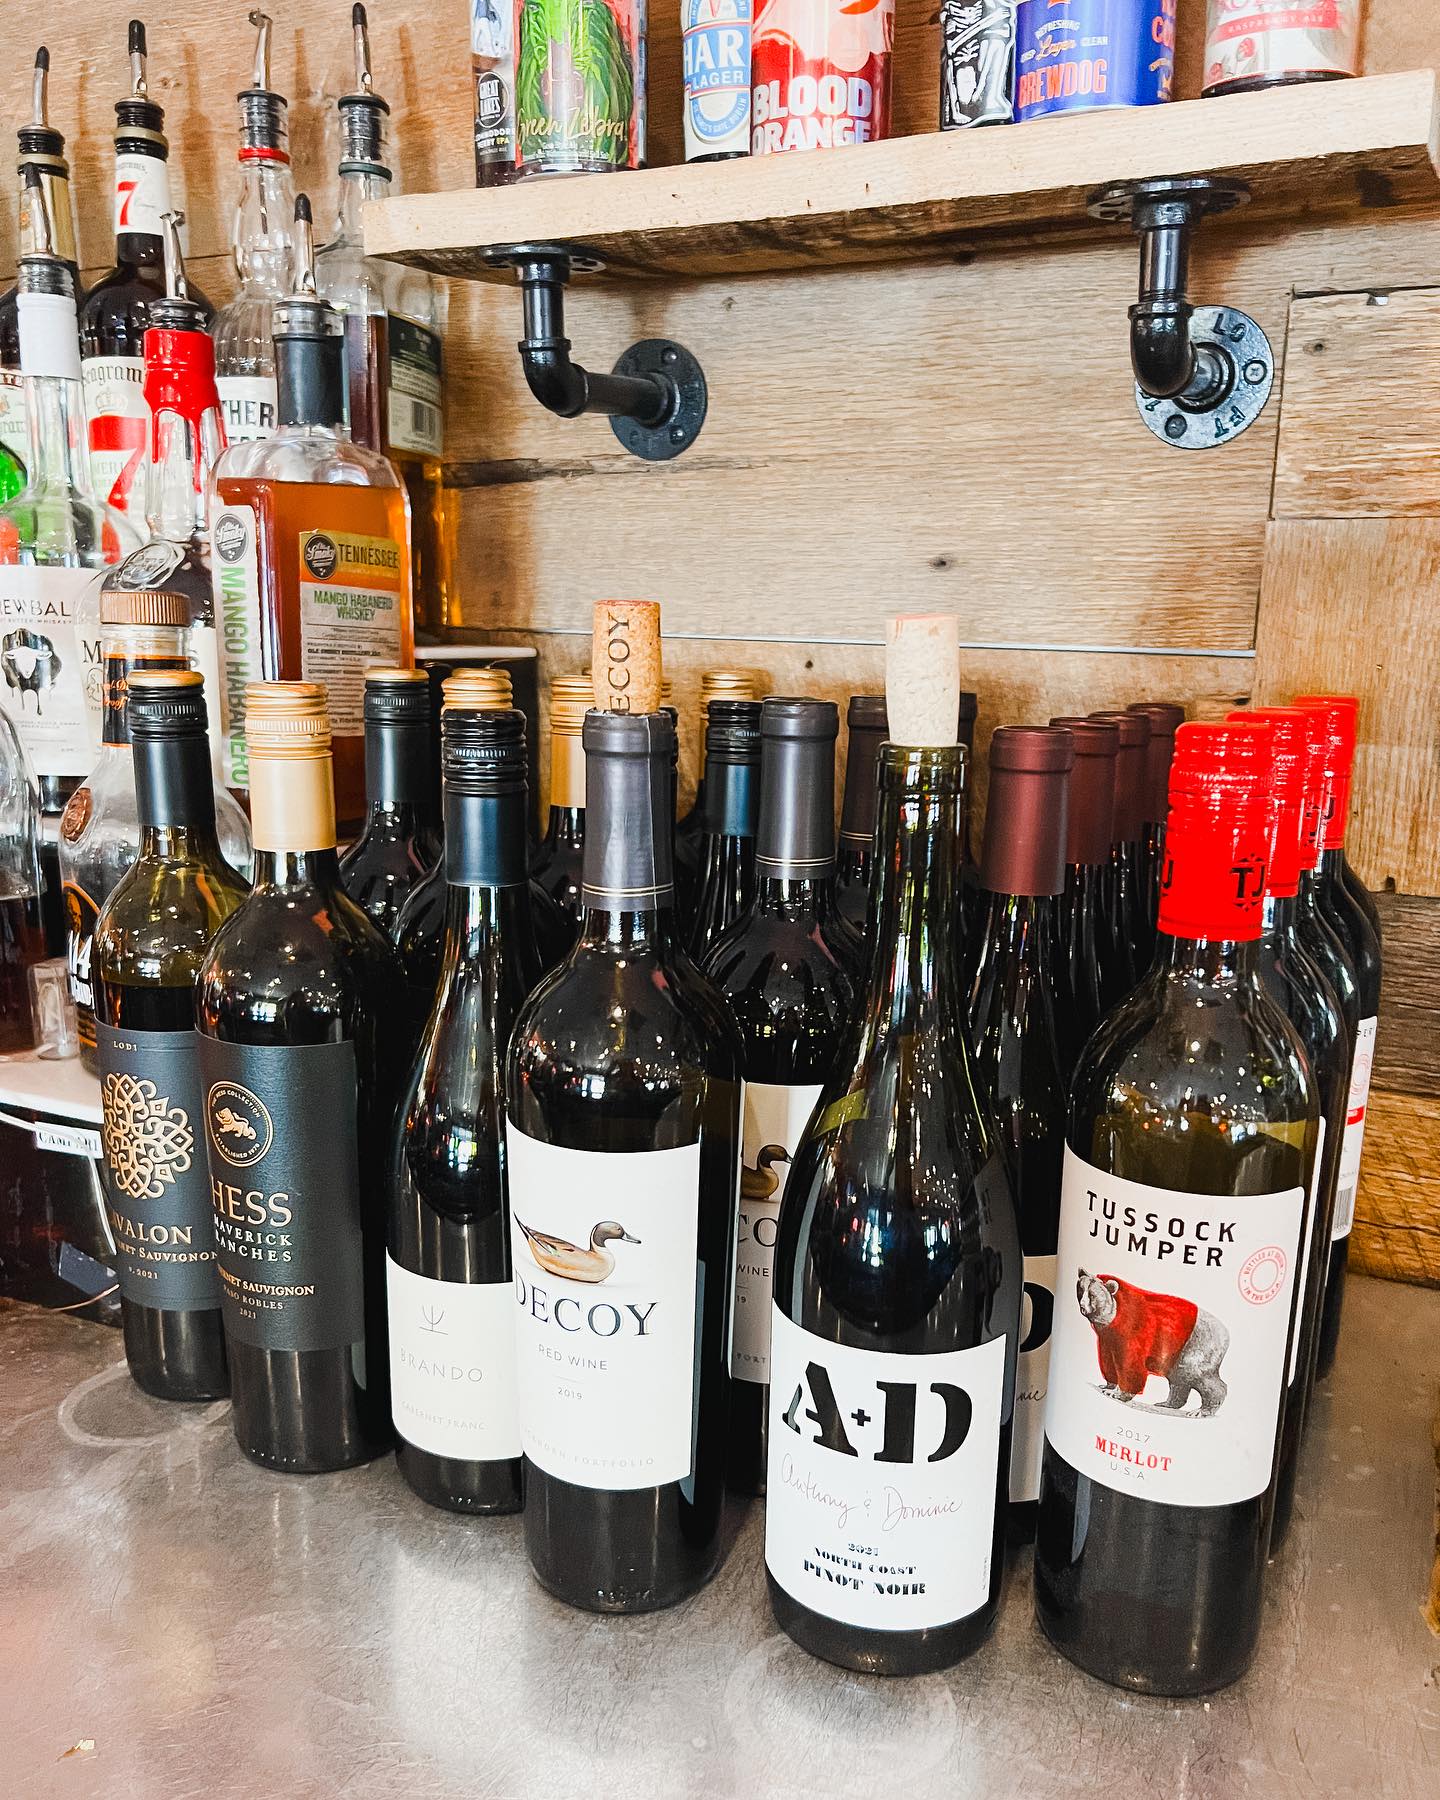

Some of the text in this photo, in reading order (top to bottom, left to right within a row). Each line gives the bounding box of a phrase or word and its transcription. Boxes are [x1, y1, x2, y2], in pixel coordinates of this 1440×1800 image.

[692, 70, 744, 90] LAGER
[1018, 58, 1108, 109] BREWDOG
[753, 74, 873, 127] BLOOD
[752, 116, 872, 156] ORANGE
[116, 180, 139, 227] 7
[88, 414, 147, 512] 7
[338, 543, 399, 568] TENNESSEE
[220, 567, 248, 654] MANGO
[313, 590, 393, 610] MANGO HABANERO
[336, 606, 376, 621] WHISKEY
[607, 607, 631, 712] ECOY
[1229, 864, 1266, 900] TJ
[227, 1089, 261, 1119] COLLECTION
[211, 1173, 293, 1228] HESS
[1086, 1190, 1238, 1243] TUSSOCK
[213, 1212, 293, 1246] MAVERICK
[1089, 1219, 1224, 1268] JUMPER
[242, 1294, 284, 1310] ROBLES
[243, 1280, 315, 1297] SAUVIGNON
[514, 1268, 660, 1337] DECOY
[400, 1347, 483, 1383] BRANDO
[538, 1343, 609, 1371] RED WINE
[557, 1386, 584, 1400] 2019
[447, 1417, 488, 1431] FRANC
[781, 1360, 973, 1465] A+D
[1094, 1434, 1173, 1472] MERLOT
[1116, 1426, 1151, 1444] 2017
[781, 1453, 857, 1530] Anthony
[881, 1486, 963, 1532] Dominic
[814, 1546, 917, 1575] NORTH COAST
[847, 1542, 879, 1557] 2021
[803, 1559, 926, 1596] PINOT NOIR
